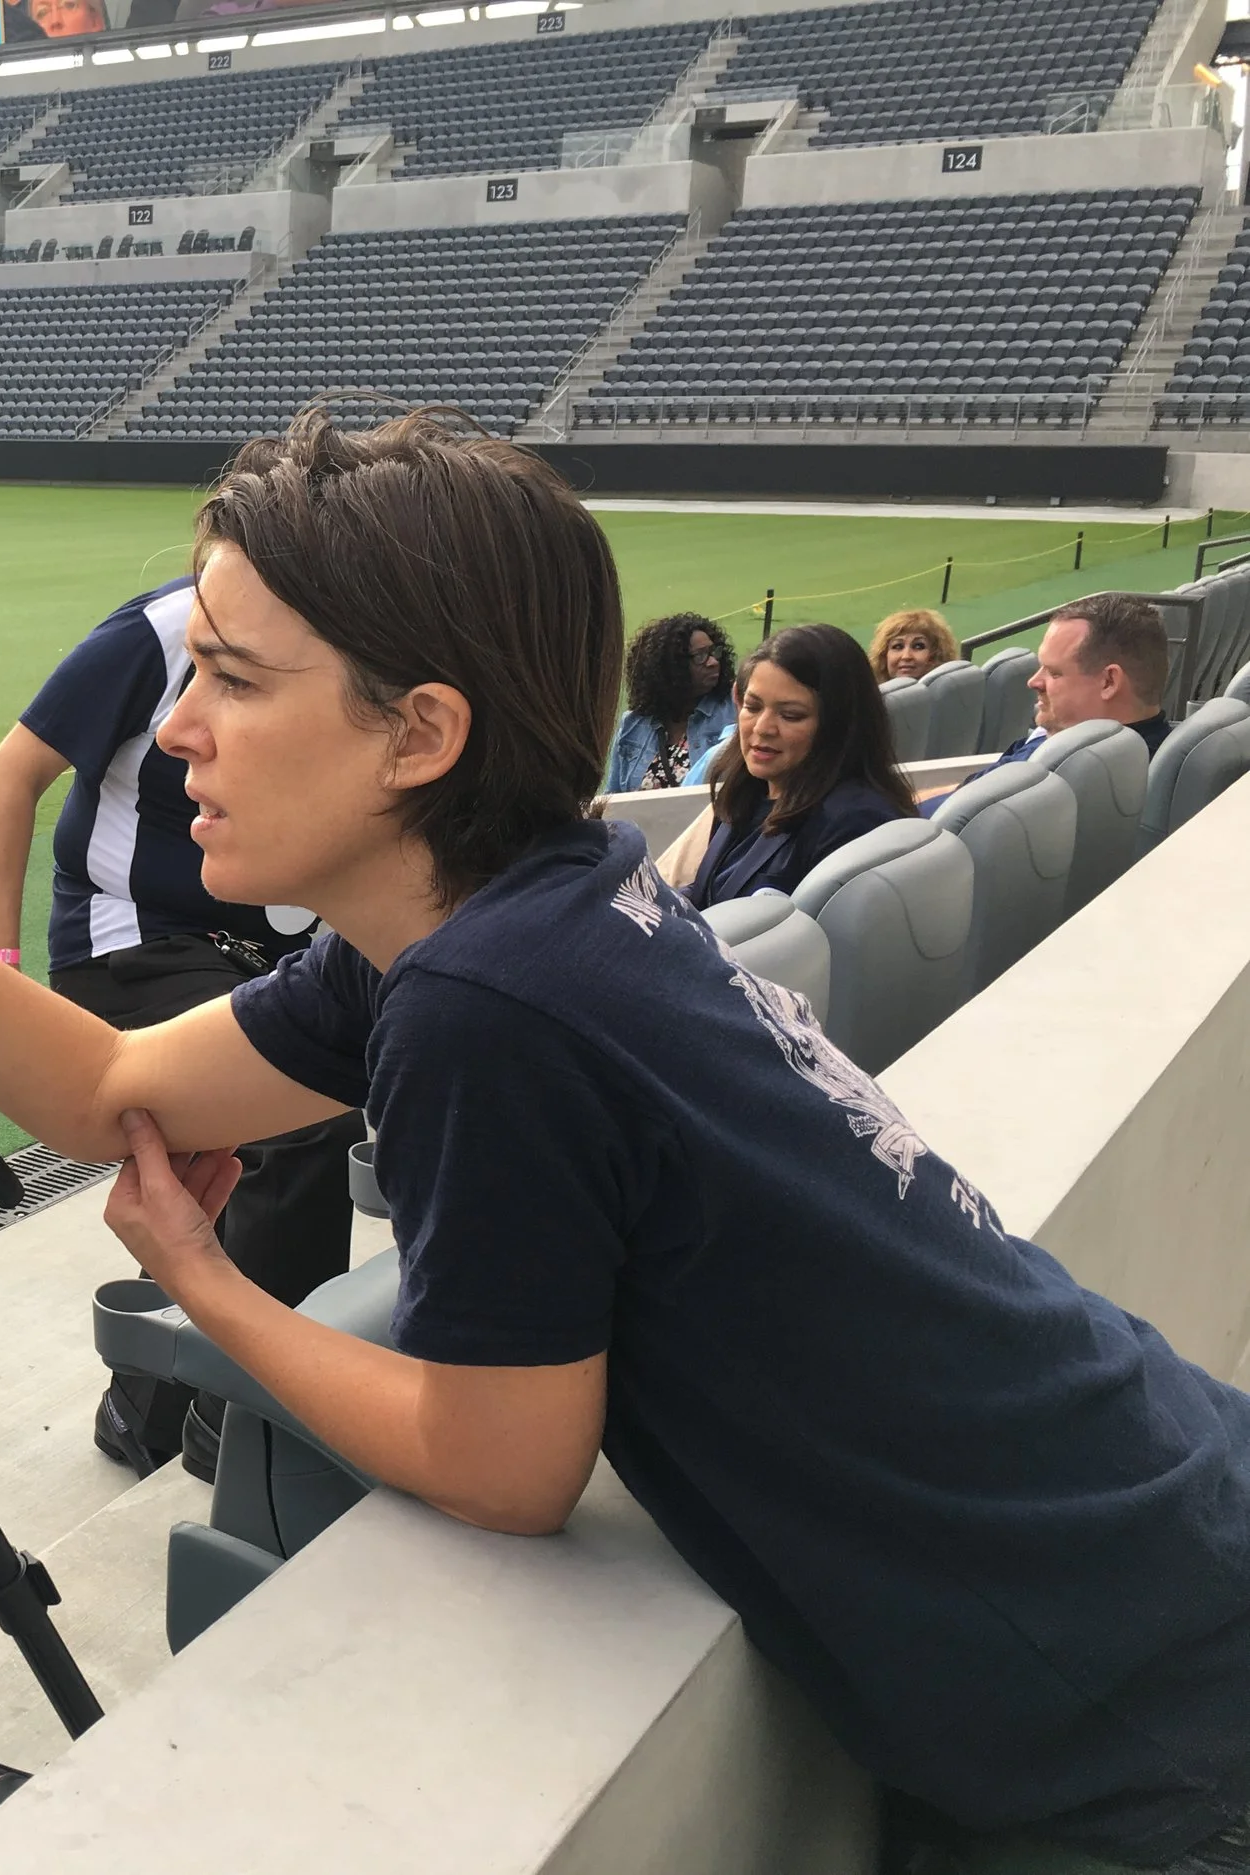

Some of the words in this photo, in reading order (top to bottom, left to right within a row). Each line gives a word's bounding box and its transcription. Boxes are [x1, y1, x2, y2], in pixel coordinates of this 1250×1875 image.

[539, 16, 562, 30] 223
[210, 56, 230, 69] 222
[948, 153, 977, 169] 124
[490, 184, 514, 199] 123
[131, 209, 151, 223] 122
